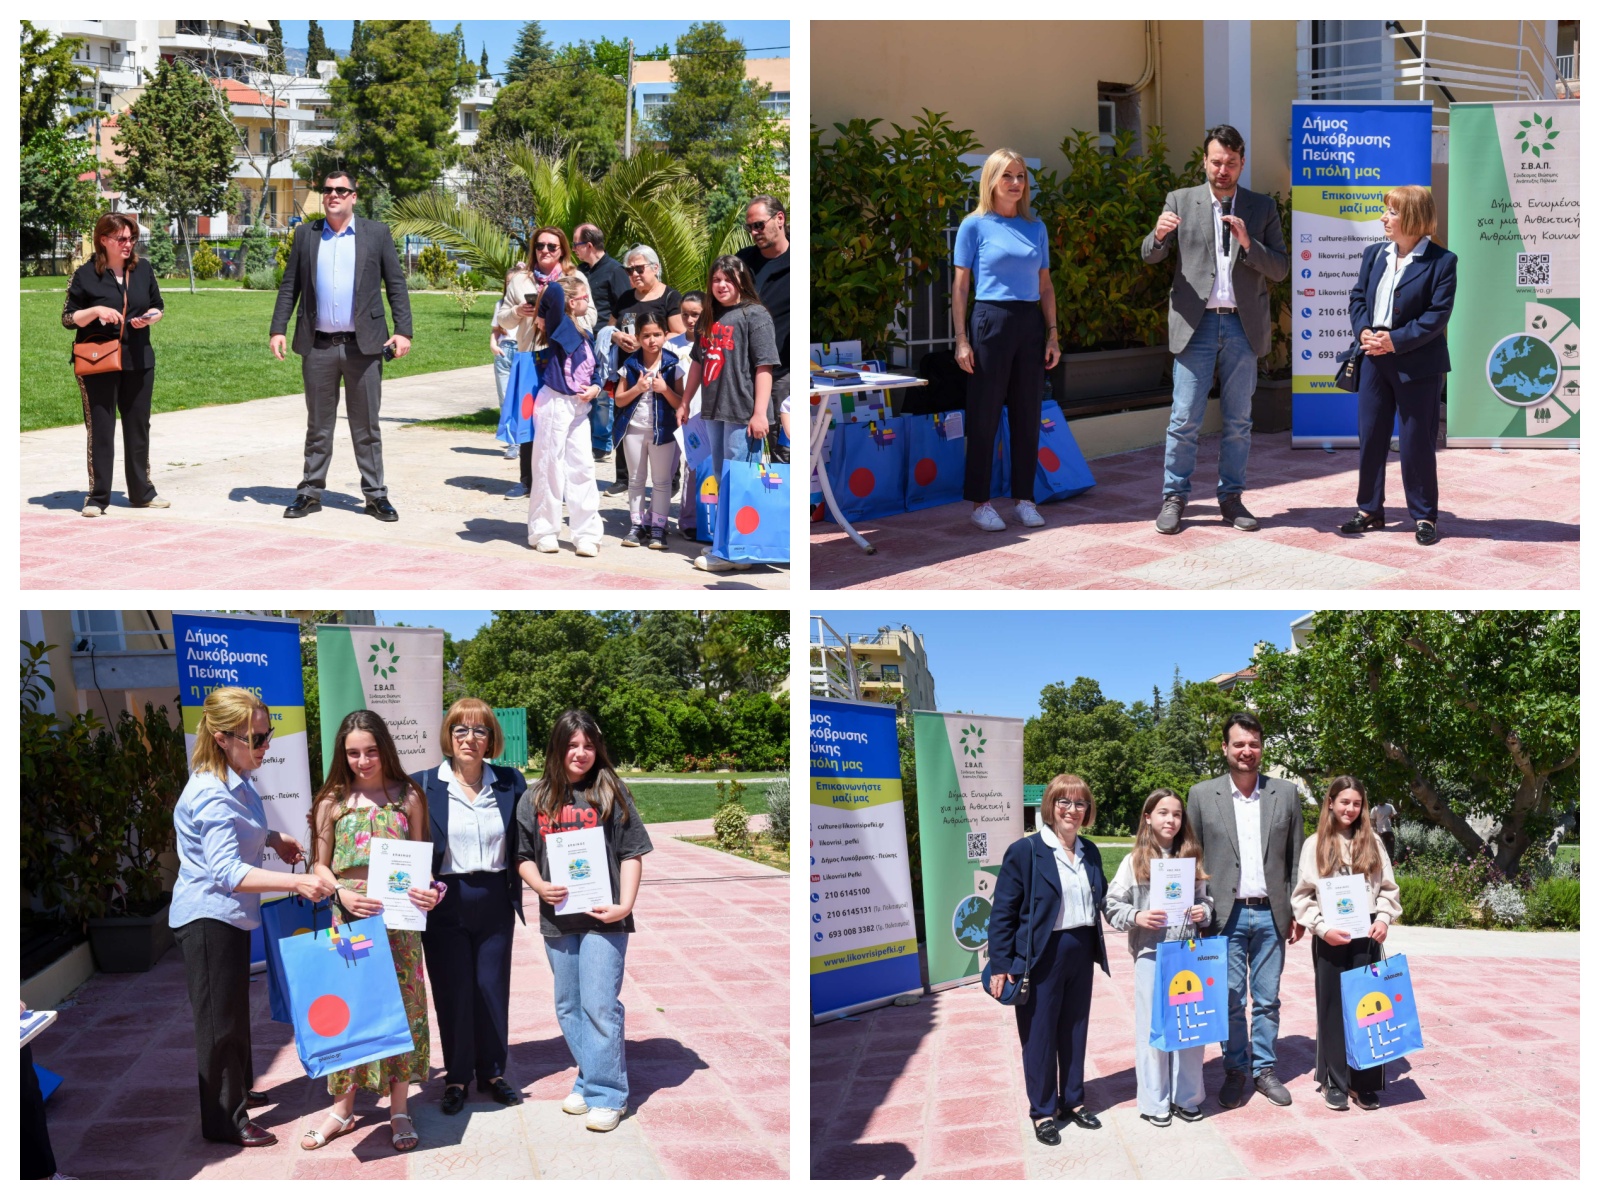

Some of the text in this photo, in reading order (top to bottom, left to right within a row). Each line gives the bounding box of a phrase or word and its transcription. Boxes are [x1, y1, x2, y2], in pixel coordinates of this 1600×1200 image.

[1302, 116, 1348, 131] Δήμος
[1302, 132, 1391, 148] Λυκόβρυσης
[1302, 148, 1355, 163] Πεύκης
[1302, 164, 1381, 180] η πόλη μας
[1521, 162, 1551, 170] Σ.Β.Α.Π.
[1322, 190, 1384, 203] Επικοινωνή
[1339, 203, 1385, 214] μαζί μας
[1491, 198, 1522, 213] Δήμοι
[1477, 217, 1494, 227] για
[1500, 217, 1518, 229] μια
[1318, 234, 1392, 243] culture@likovrisipefk
[1542, 231, 1580, 241] Κοινων
[1318, 252, 1364, 260] likovrisi_pefk
[1318, 270, 1360, 279] Δήμος Λυκό
[1318, 288, 1347, 296] Likovrisi
[1318, 308, 1335, 316] 210
[1318, 329, 1355, 337] 210 614
[1318, 351, 1334, 359] 693
[185, 629, 229, 647] Δήμος
[187, 647, 268, 666] Λυκόβρυσης
[189, 665, 239, 682] Πεύκης
[191, 685, 200, 699] η
[810, 714, 832, 727] μος
[810, 726, 868, 744] κόβρυσης
[810, 741, 841, 757] ύκης
[842, 761, 863, 772] μας
[816, 781, 882, 792] Επικοινωνήστε
[832, 793, 870, 804] μαζί μας
[817, 822, 885, 831] culture@likovrisipefki.gr
[821, 856, 840, 865] Δήμος
[840, 854, 875, 863] Λυκόβρυσης
[878, 852, 898, 860] Πεύκης
[823, 873, 847, 881] Likovrisi
[824, 887, 871, 899] 210 6145100
[827, 910, 841, 919] 210
[842, 906, 872, 917] 6145131
[828, 930, 842, 939] 693
[843, 927, 857, 936] 008
[858, 924, 875, 934] 3382
[823, 944, 906, 967] www.likovrisipefki.gr
